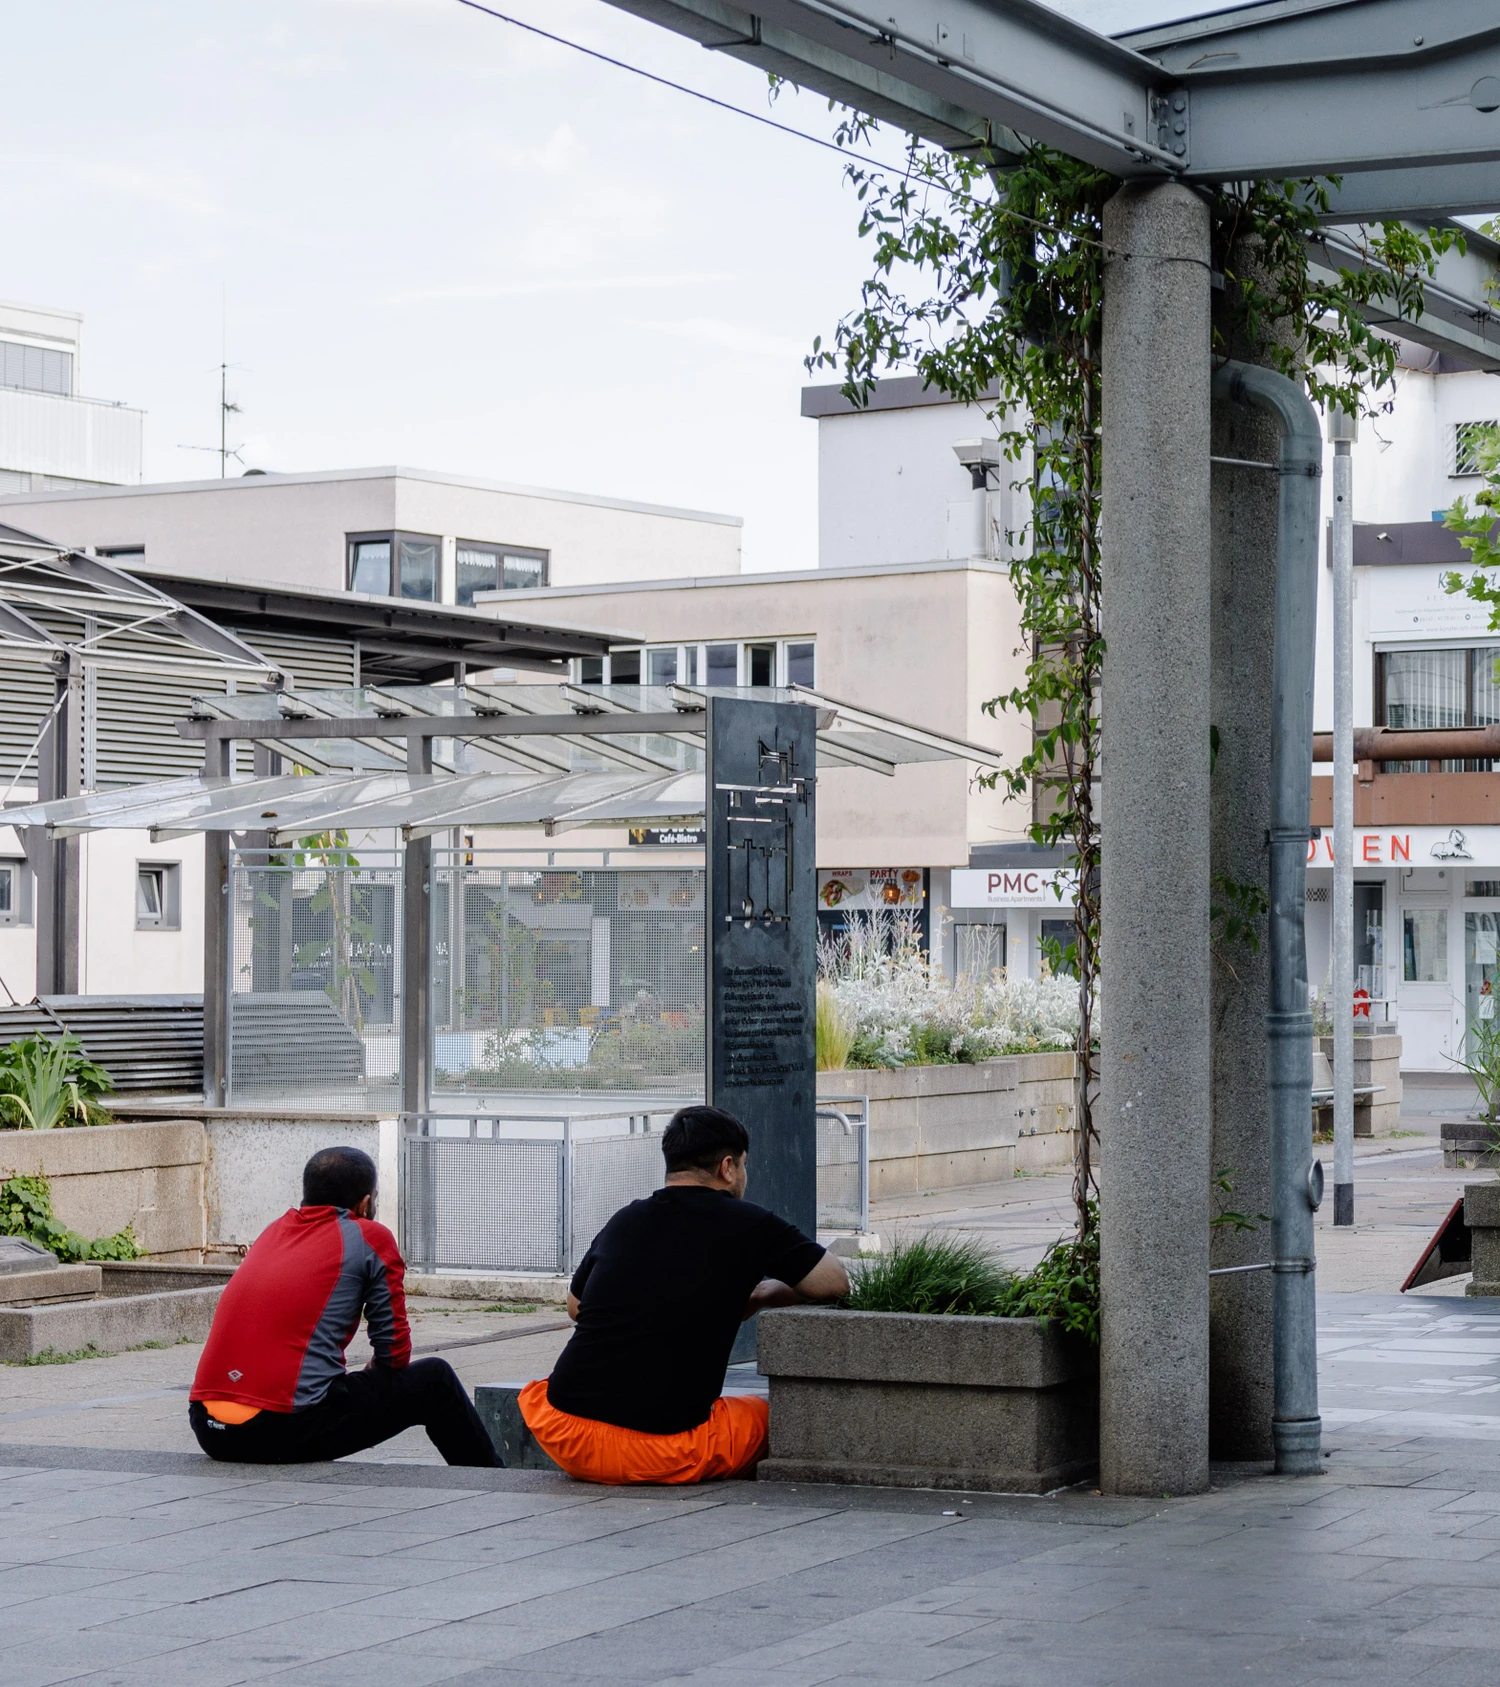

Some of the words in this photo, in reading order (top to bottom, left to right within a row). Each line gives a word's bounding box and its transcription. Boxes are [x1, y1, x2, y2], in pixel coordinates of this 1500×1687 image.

[659, 833, 698, 844] Café-Bistro
[870, 869, 899, 879] PARTY
[988, 873, 1039, 893] PMC
[987, 895, 1010, 903] Business
[1010, 895, 1042, 904] Apartments
